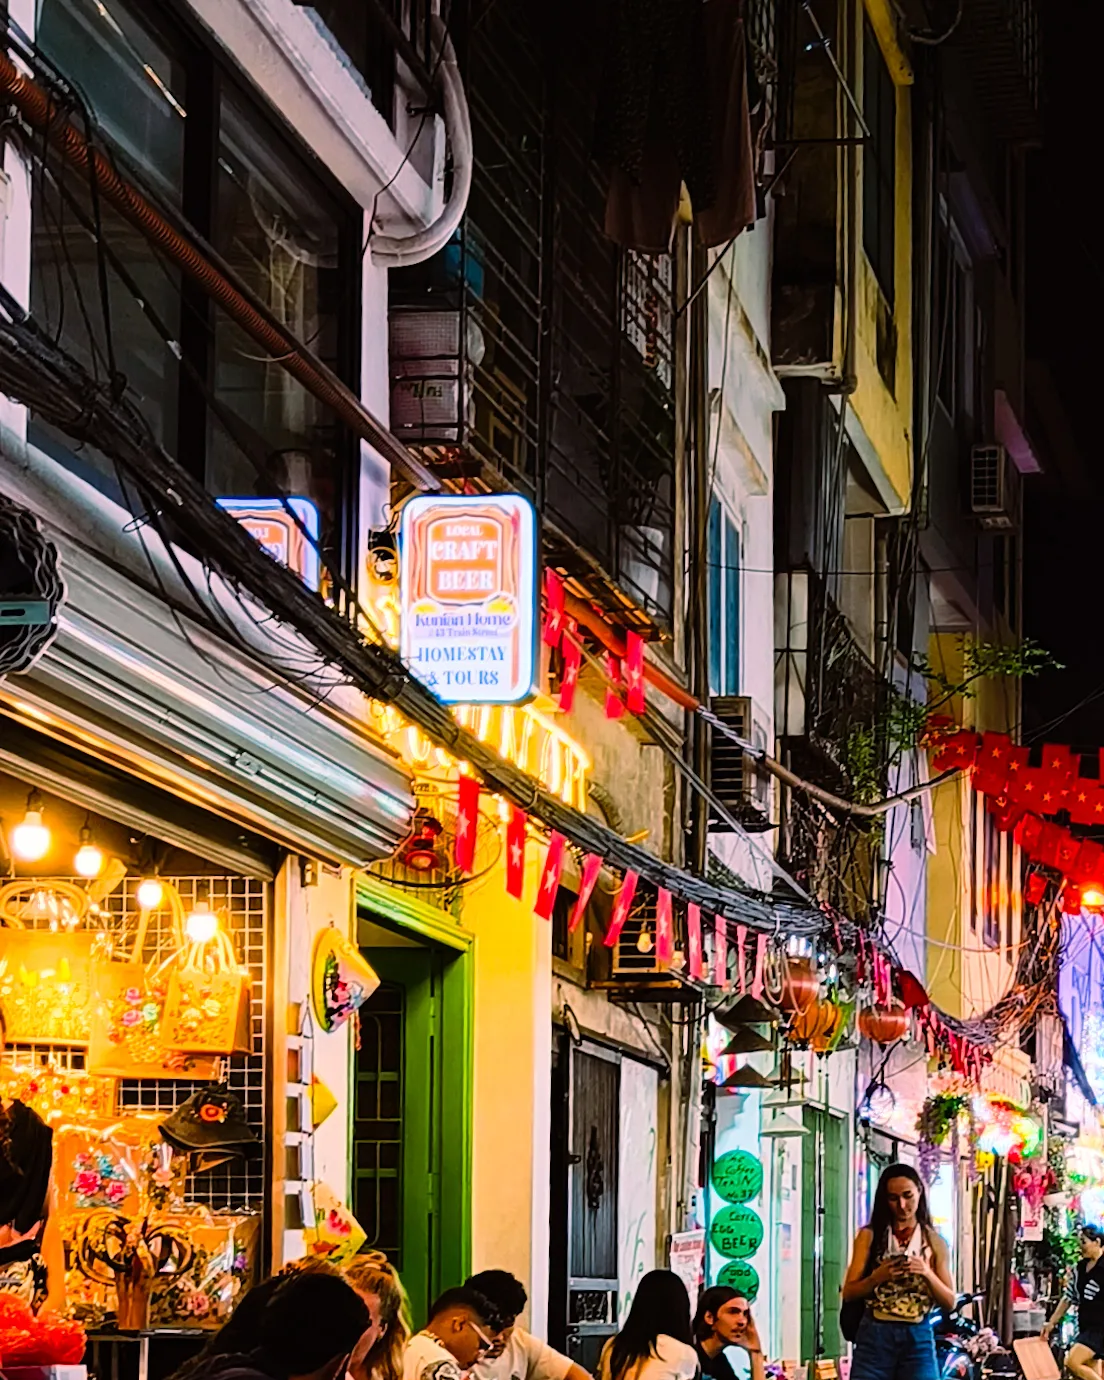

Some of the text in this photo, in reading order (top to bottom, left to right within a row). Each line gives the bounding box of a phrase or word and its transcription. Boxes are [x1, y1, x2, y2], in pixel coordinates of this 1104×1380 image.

[445, 525, 484, 537] LOCAL
[431, 541, 498, 561] CRAFT
[437, 570, 494, 591] BEER
[467, 611, 511, 627] Home
[418, 645, 508, 662] HOMESTAY
[442, 670, 499, 686] TOURS
[721, 1234, 758, 1251] BEER
